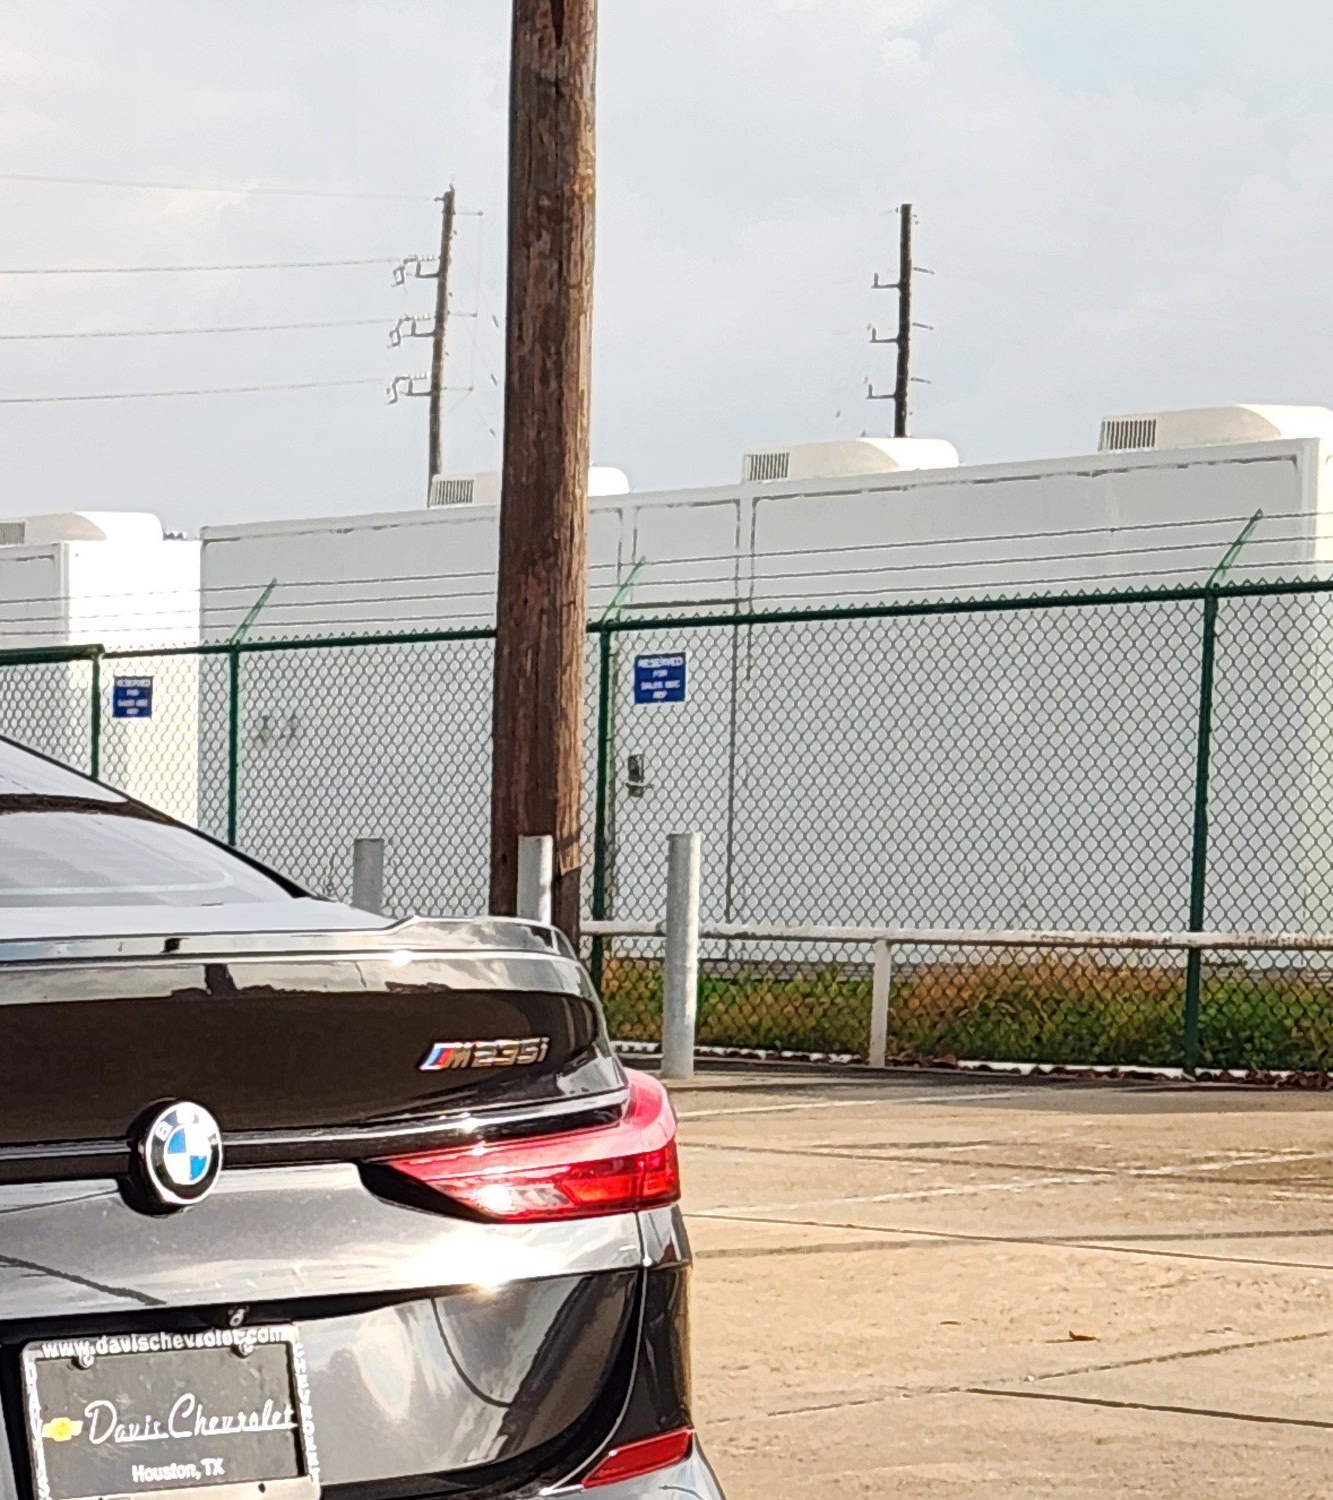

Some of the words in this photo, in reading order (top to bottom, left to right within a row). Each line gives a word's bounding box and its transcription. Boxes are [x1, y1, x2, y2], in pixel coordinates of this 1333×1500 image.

[41, 1328, 285, 1358] www.davischevrolet.com
[84, 1399, 170, 1445] Davis
[167, 1393, 299, 1438] Chevrolet
[132, 1461, 201, 1483] Houston,
[201, 1457, 225, 1476] TX
